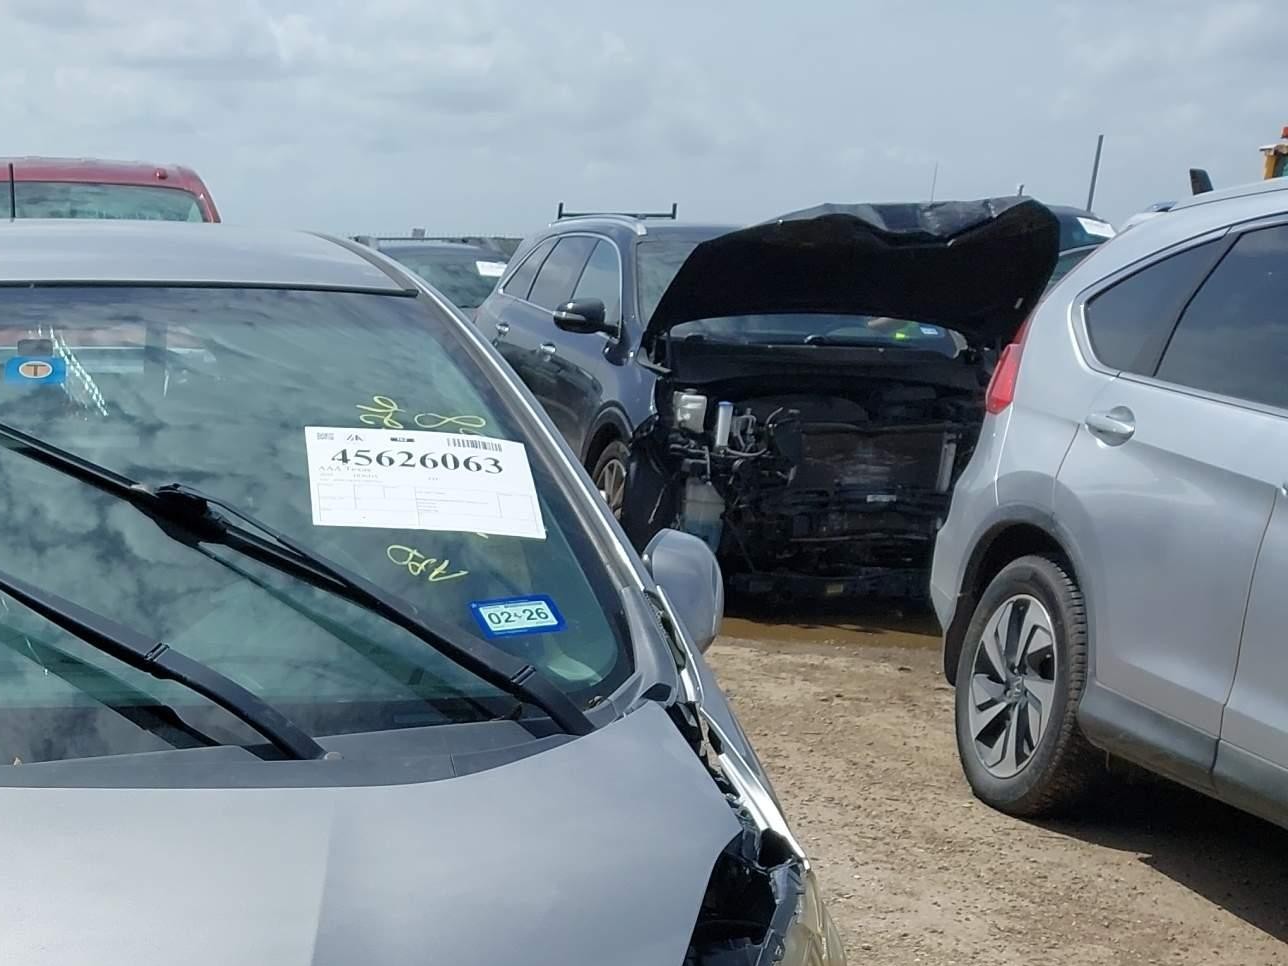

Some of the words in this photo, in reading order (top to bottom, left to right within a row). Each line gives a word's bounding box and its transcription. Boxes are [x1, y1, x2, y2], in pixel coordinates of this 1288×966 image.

[331, 448, 504, 474] 45626063
[487, 611, 515, 625] 02
[522, 607, 549, 621] 26
